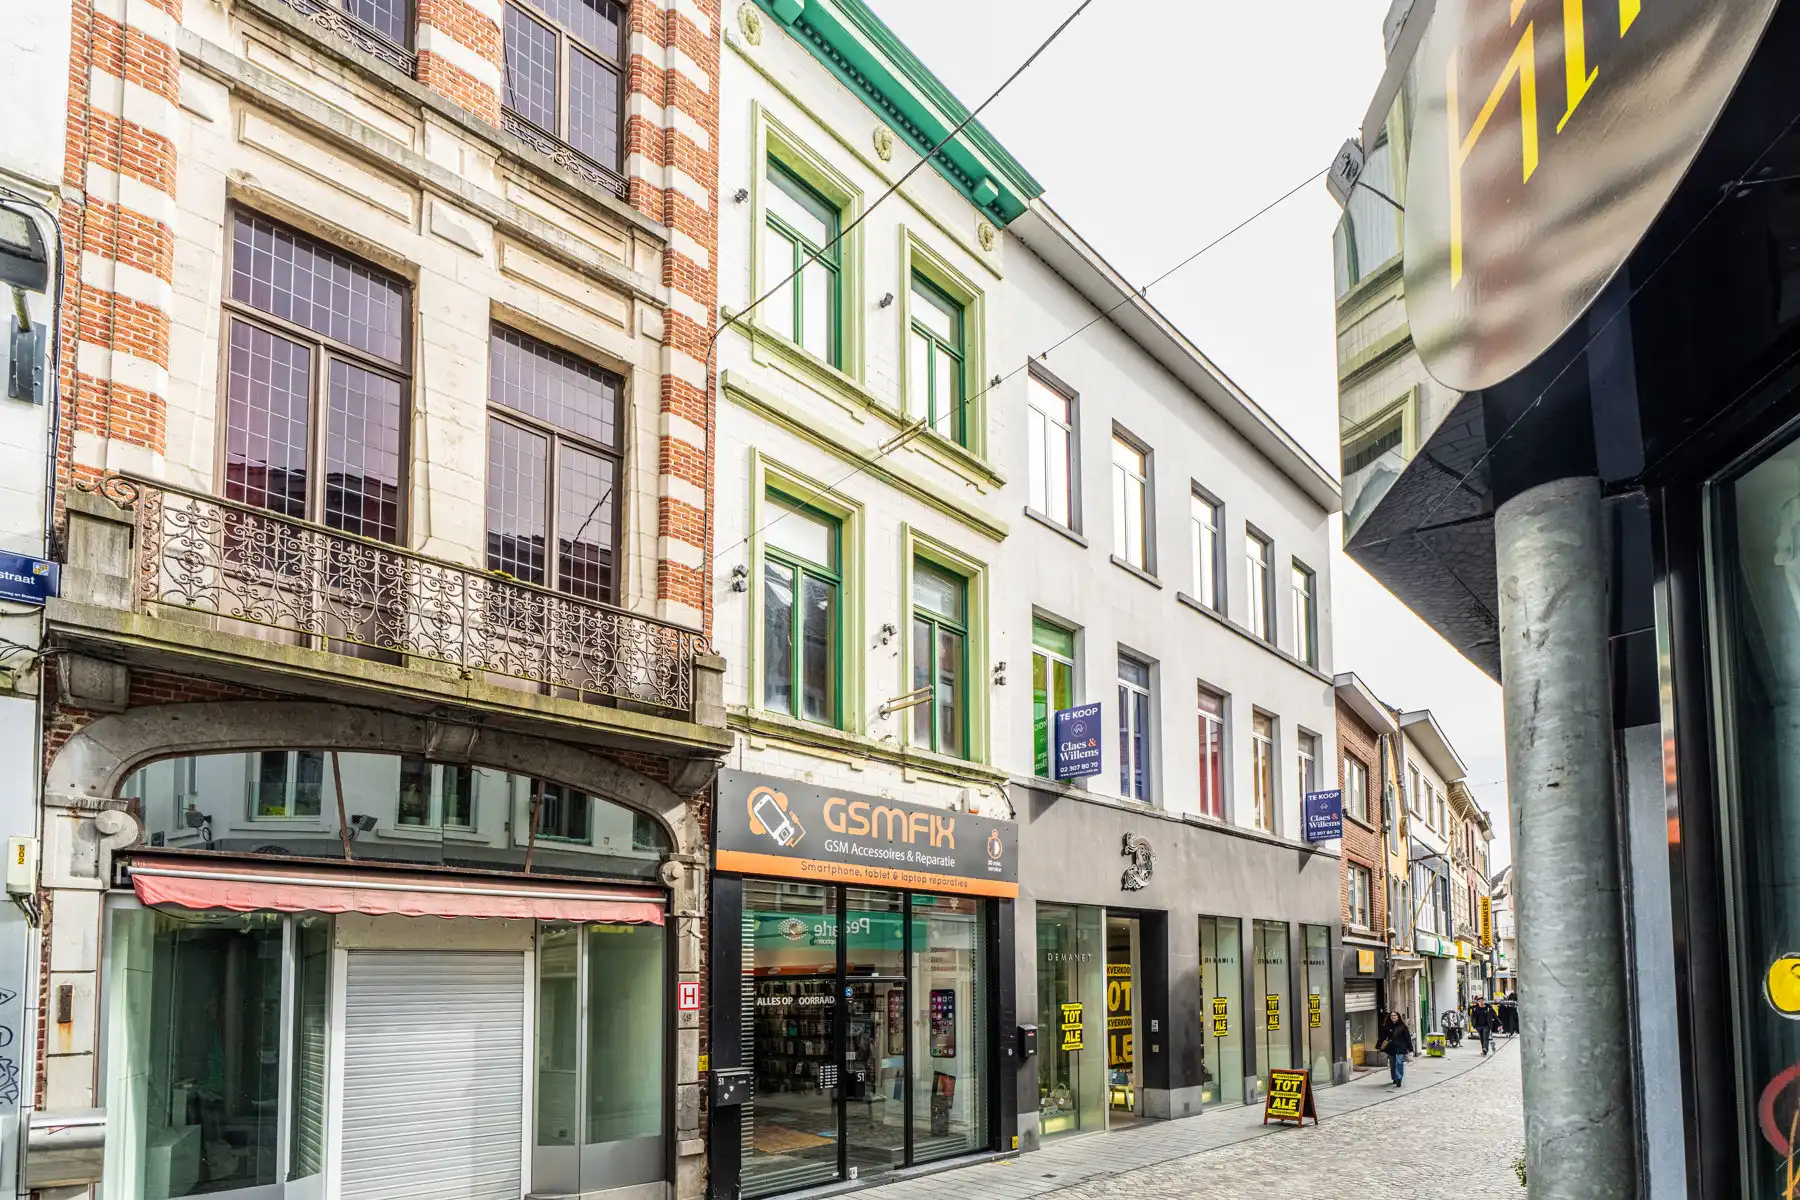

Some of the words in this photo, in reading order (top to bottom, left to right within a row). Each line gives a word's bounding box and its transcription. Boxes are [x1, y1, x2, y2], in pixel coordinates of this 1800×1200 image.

[1060, 712, 1070, 721] TE
[1072, 708, 1098, 719] KOOP
[1061, 742, 1086, 752] Claes
[1088, 738, 1096, 747] &
[1060, 749, 1099, 761] Willems
[823, 797, 955, 849] GSMFIX
[1309, 820, 1340, 828] Willems
[824, 839, 849, 854] GSM
[851, 843, 905, 861] Accessoires
[907, 850, 914, 861] &
[916, 852, 955, 867] Reparatie
[801, 861, 862, 878] Smartphone,
[865, 868, 890, 880] tablet
[902, 872, 927, 884] laptop
[929, 876, 968, 888] reparaties
[1048, 953, 1092, 961] DEMANET
[684, 988, 695, 1004] H
[757, 997, 781, 1006] ALLES
[798, 996, 835, 1005] OORRAAD
[1214, 1004, 1226, 1014] TOT
[1268, 1001, 1277, 1009] TOT
[1310, 1000, 1319, 1009] TOT
[1064, 1011, 1080, 1023] TOT
[1269, 1016, 1278, 1025] ALE
[1215, 1020, 1226, 1031] ALE
[1064, 1031, 1081, 1043] ALE
[857, 1073, 865, 1082] 51
[1274, 1080, 1300, 1091] TOT
[1272, 1098, 1297, 1109] ALE
